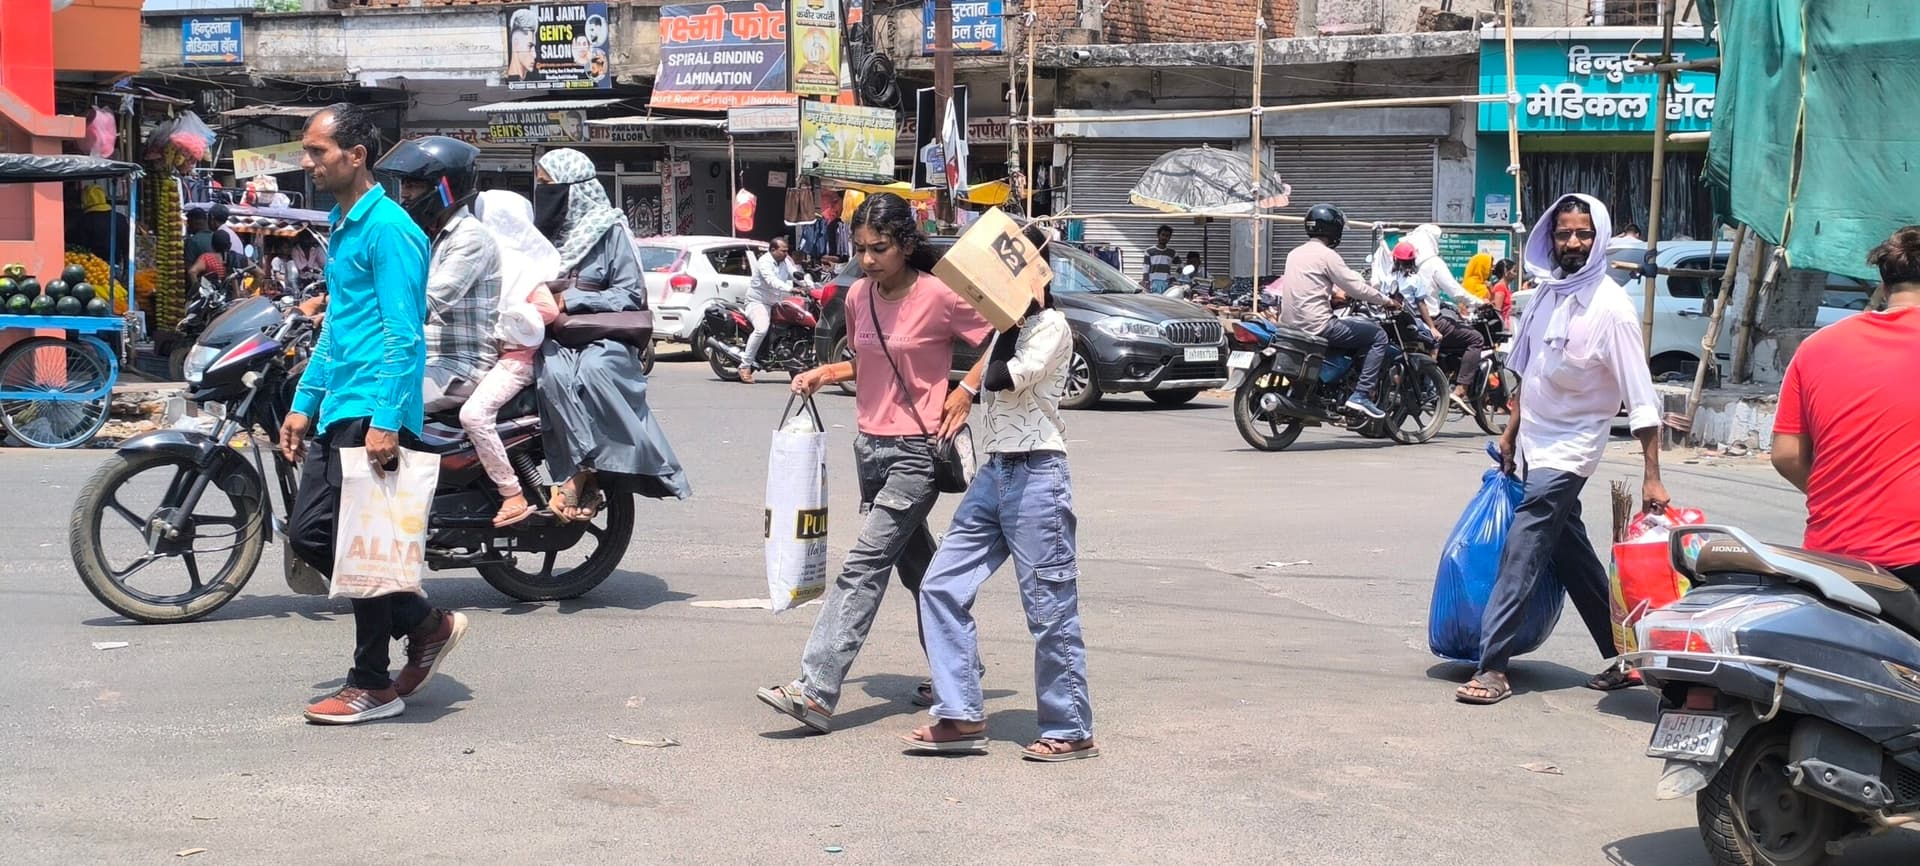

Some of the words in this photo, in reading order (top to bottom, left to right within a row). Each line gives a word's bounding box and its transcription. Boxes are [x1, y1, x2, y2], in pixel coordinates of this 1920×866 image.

[539, 7, 554, 22] JAI
[556, 6, 586, 21] JANTA
[191, 19, 232, 39] हिन्दुस्तान
[540, 24, 573, 41] GENT'S
[974, 18, 997, 40] हॉल
[185, 37, 220, 53] मेडिकल
[220, 37, 238, 53] हॉल
[541, 44, 572, 59] SALON
[668, 53, 711, 66] SPIRAL
[713, 50, 764, 65] BINDING
[676, 71, 752, 86] LAMINATION
[1526, 82, 1652, 120] मेडिकल
[504, 112, 519, 124] JAI
[520, 112, 547, 124] JANTA
[489, 125, 523, 138] GENT'S
[524, 124, 550, 137] SALON
[612, 132, 644, 142] SALOON
[346, 535, 424, 566] ALFA
[1711, 545, 1749, 553] HONDA
[1670, 715, 1713, 733] JH11A
